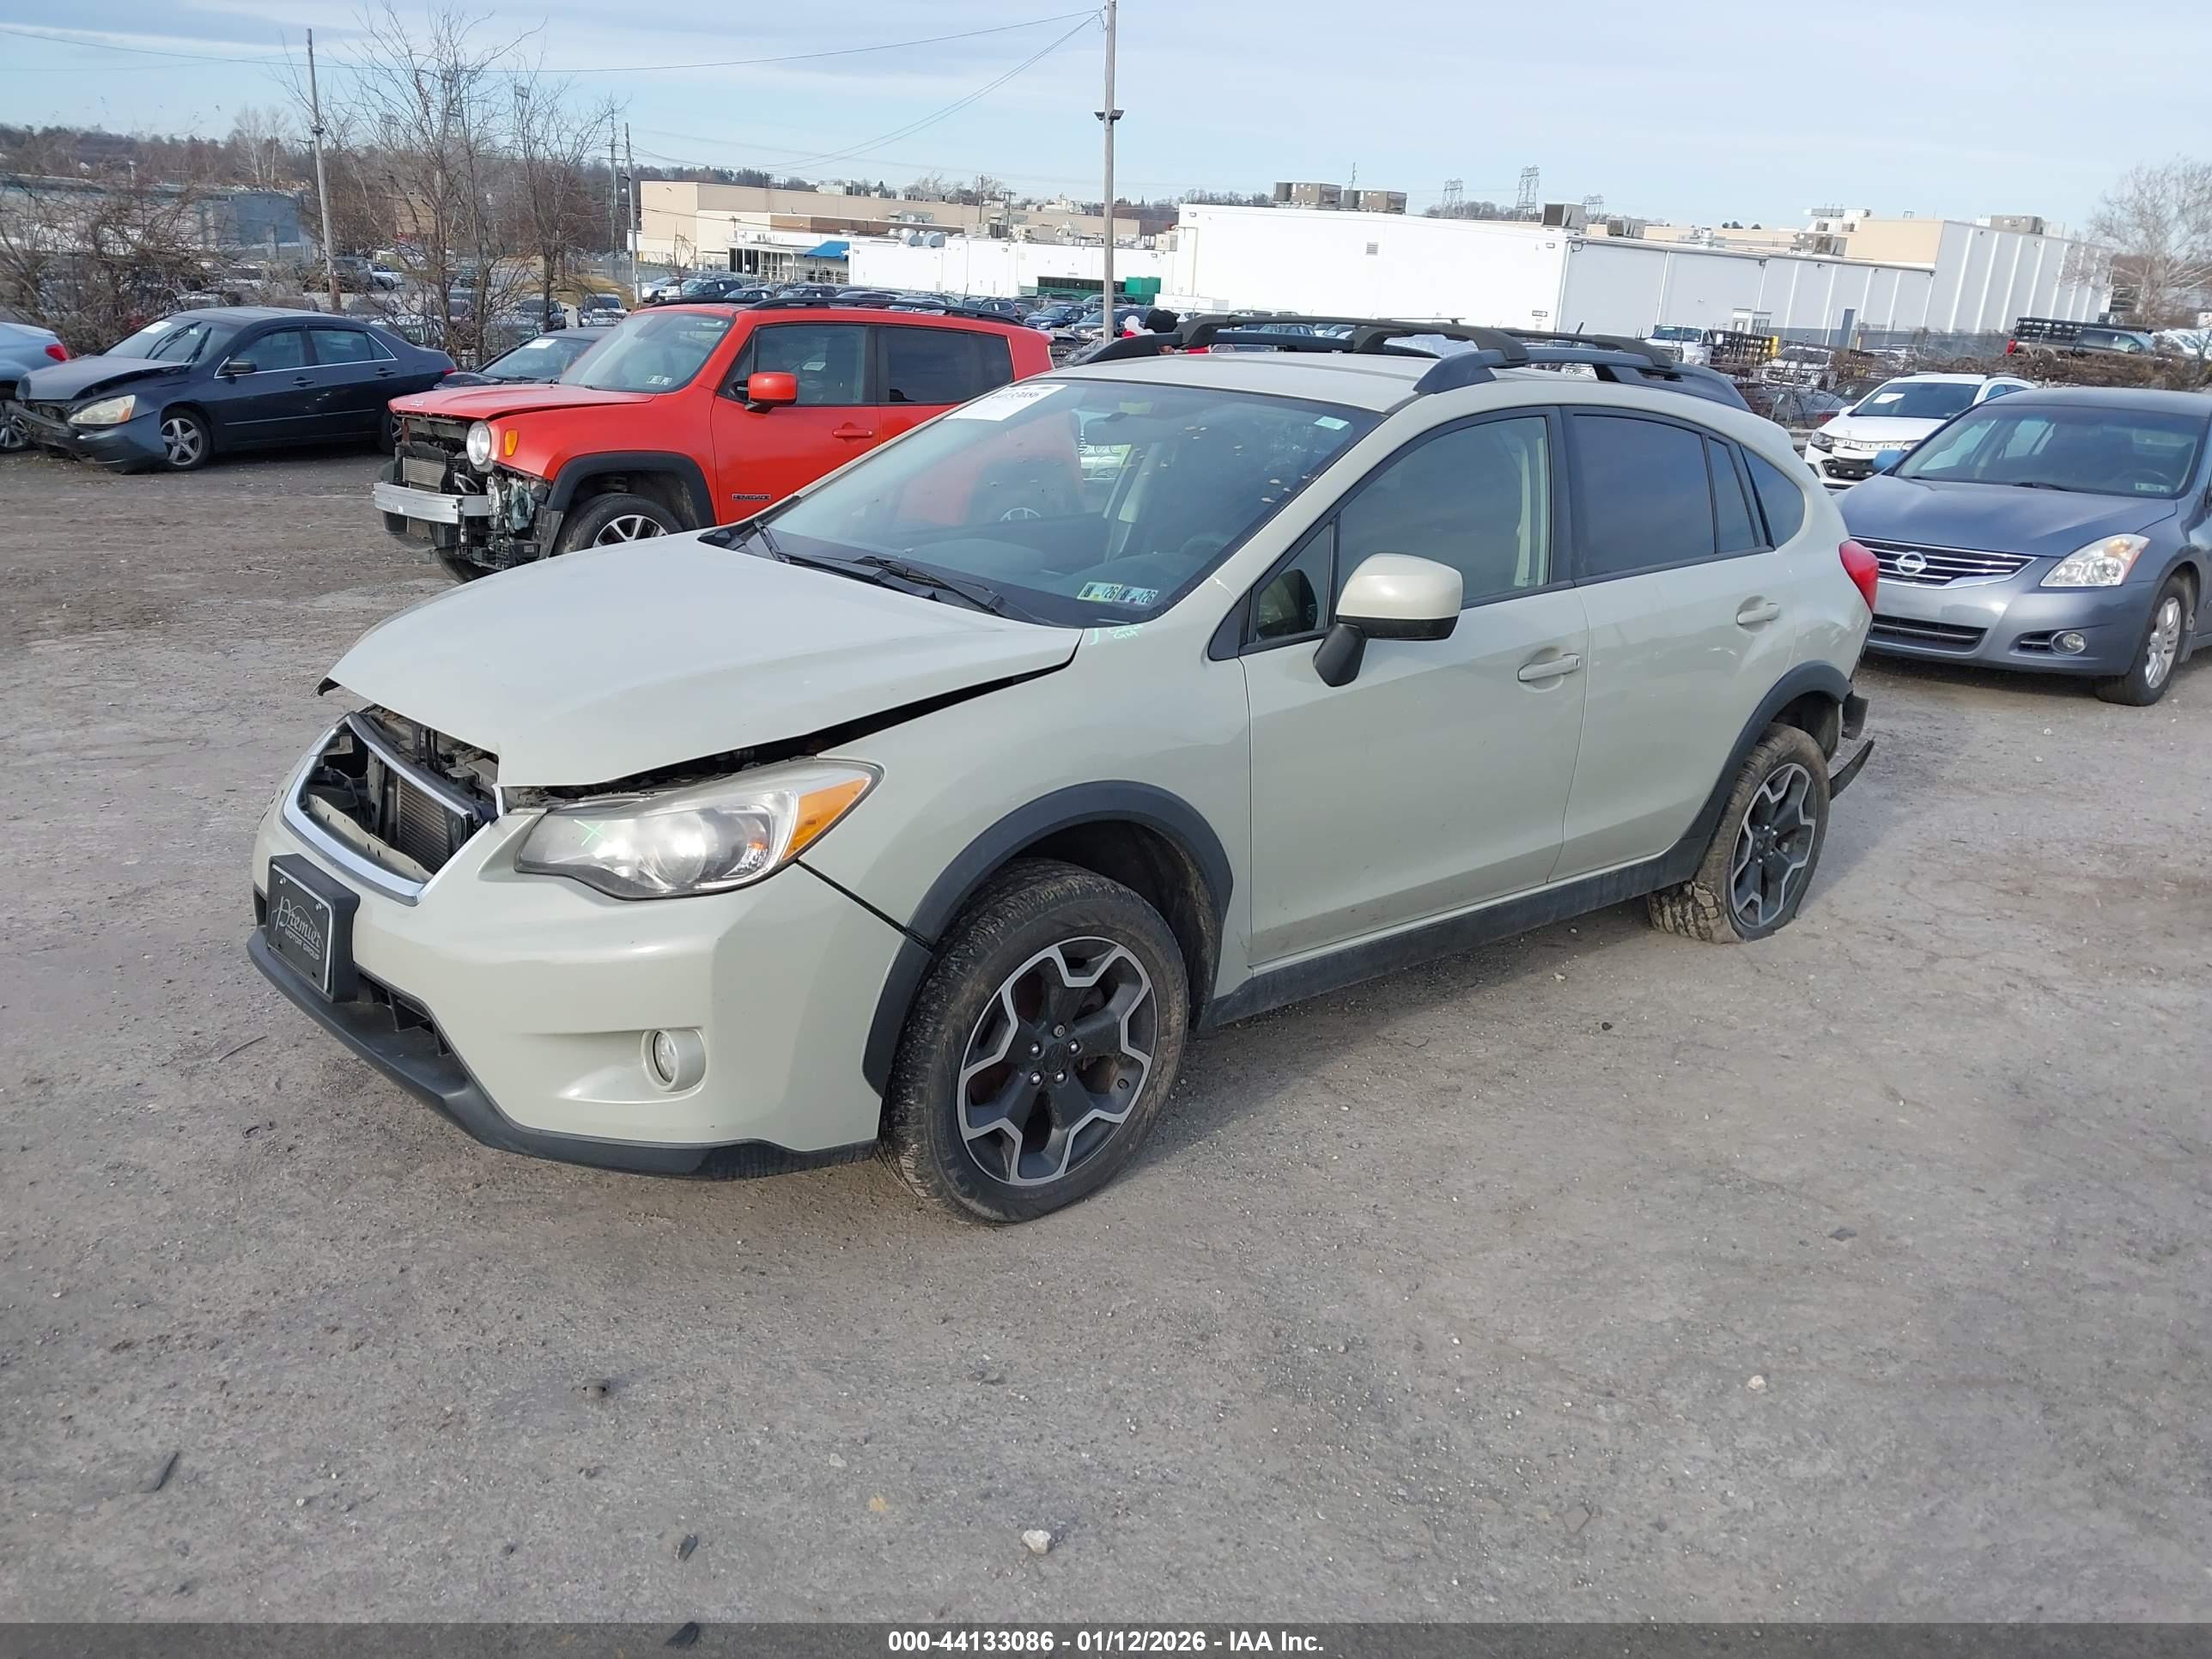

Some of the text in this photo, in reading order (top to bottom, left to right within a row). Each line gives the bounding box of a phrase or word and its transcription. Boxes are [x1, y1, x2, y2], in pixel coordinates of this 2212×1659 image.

[274, 896, 321, 948] Premier
[284, 927, 321, 961] MOTOR GROUP
